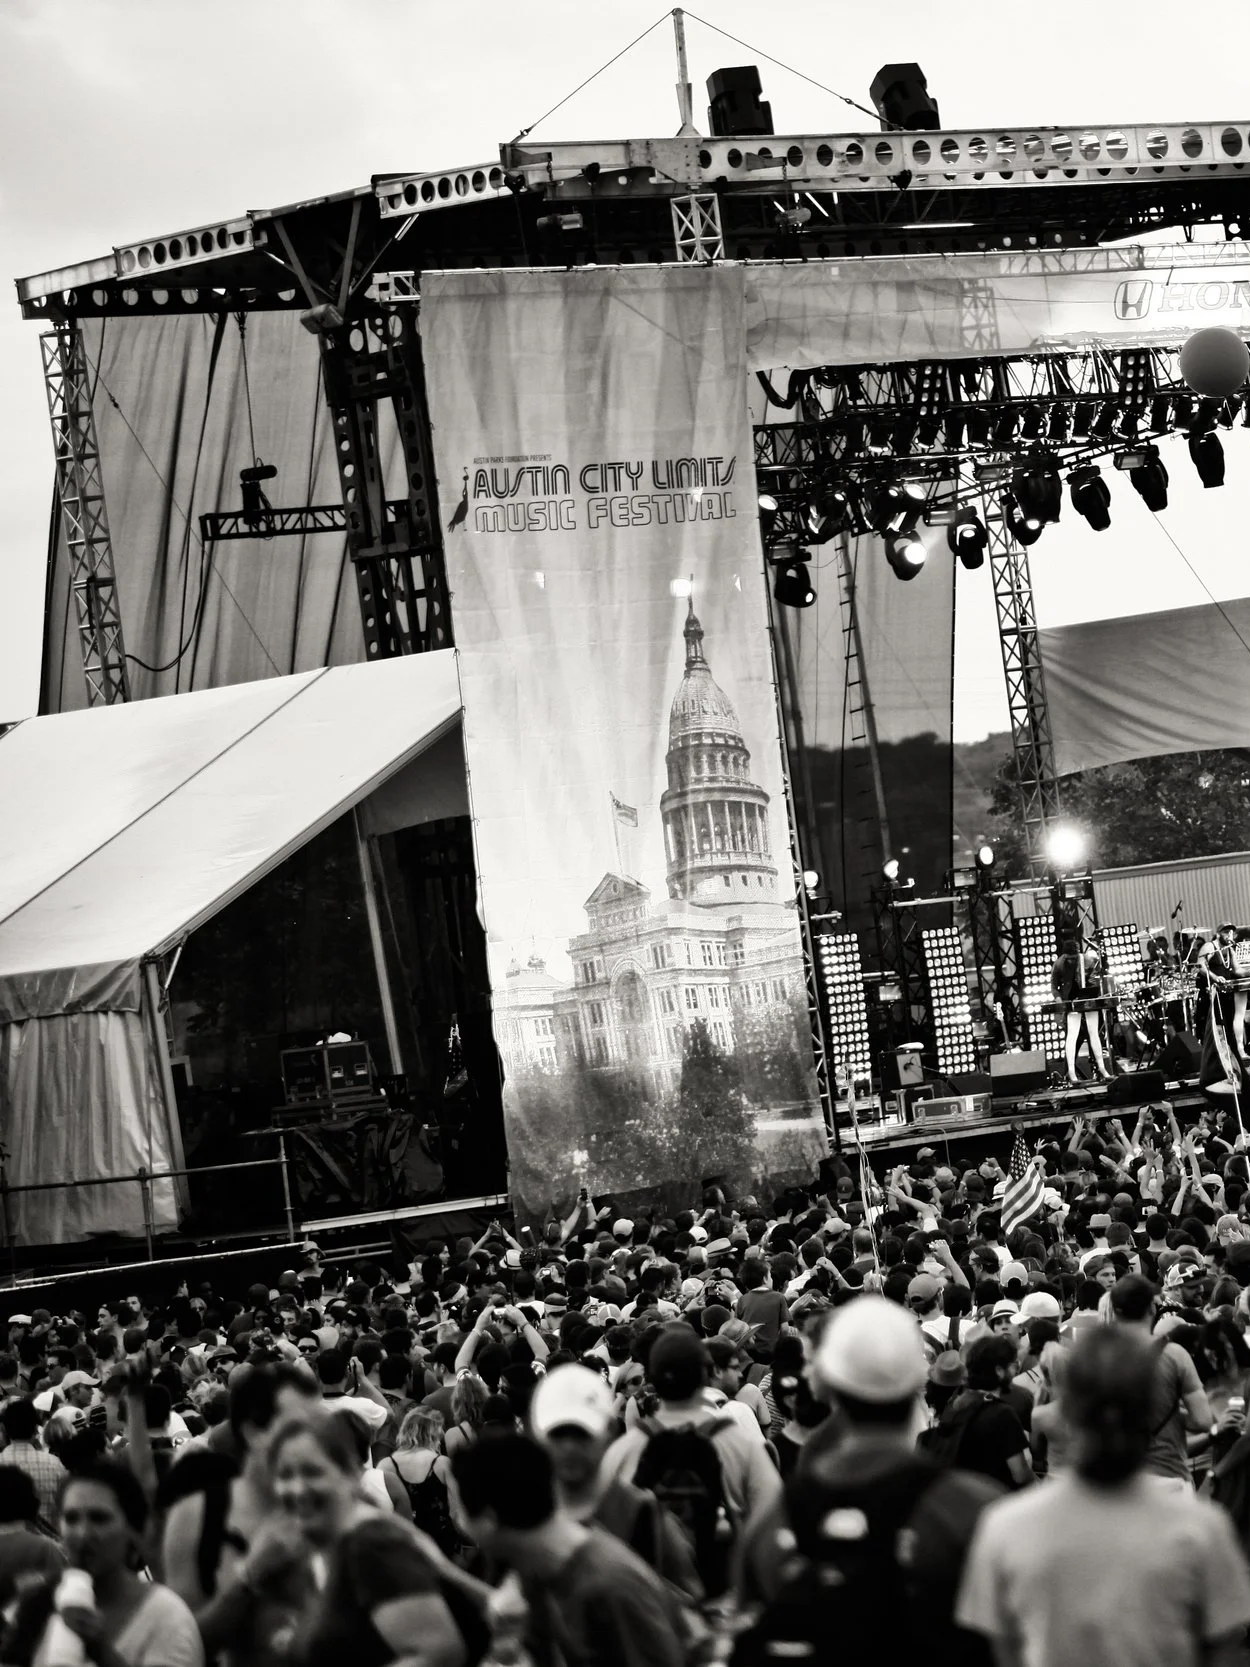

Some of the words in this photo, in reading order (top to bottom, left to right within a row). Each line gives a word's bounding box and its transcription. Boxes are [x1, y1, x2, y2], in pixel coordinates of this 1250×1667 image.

[473, 464, 572, 499] AUSTIN
[579, 461, 644, 493] CITY
[651, 456, 737, 489] LIMITS
[475, 500, 577, 533] MUSIC
[587, 492, 737, 529] FESTIVAL
